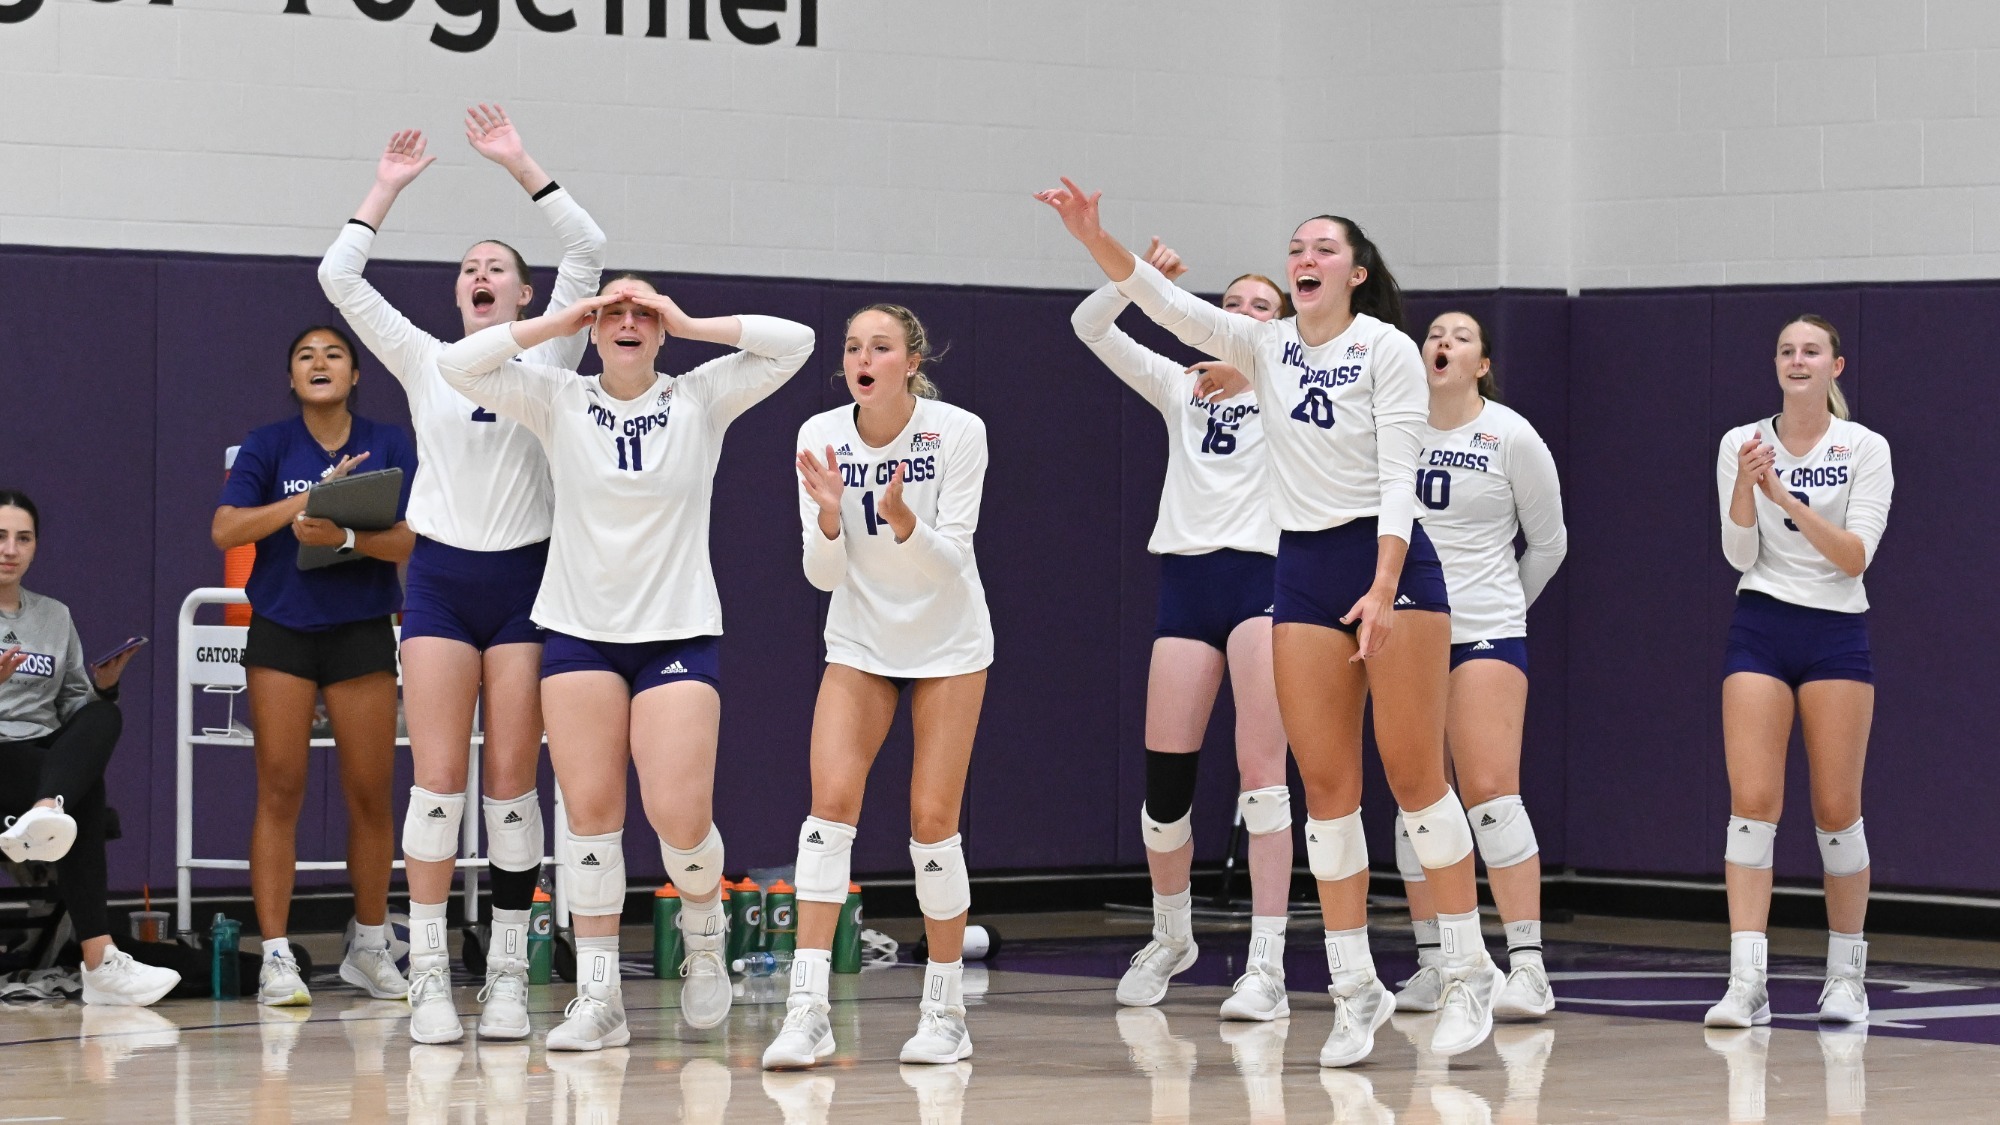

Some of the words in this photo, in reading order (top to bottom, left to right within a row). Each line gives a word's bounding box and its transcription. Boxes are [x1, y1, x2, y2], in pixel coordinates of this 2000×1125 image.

[1290, 387, 1335, 429] 20
[1201, 417, 1240, 455] 16
[616, 437, 642, 471] 11
[1429, 449, 1489, 472] CROSS
[839, 463, 868, 488] OLY
[1415, 469, 1451, 510] 10
[1791, 465, 1848, 488] CROSS
[774, 905, 790, 926] G
